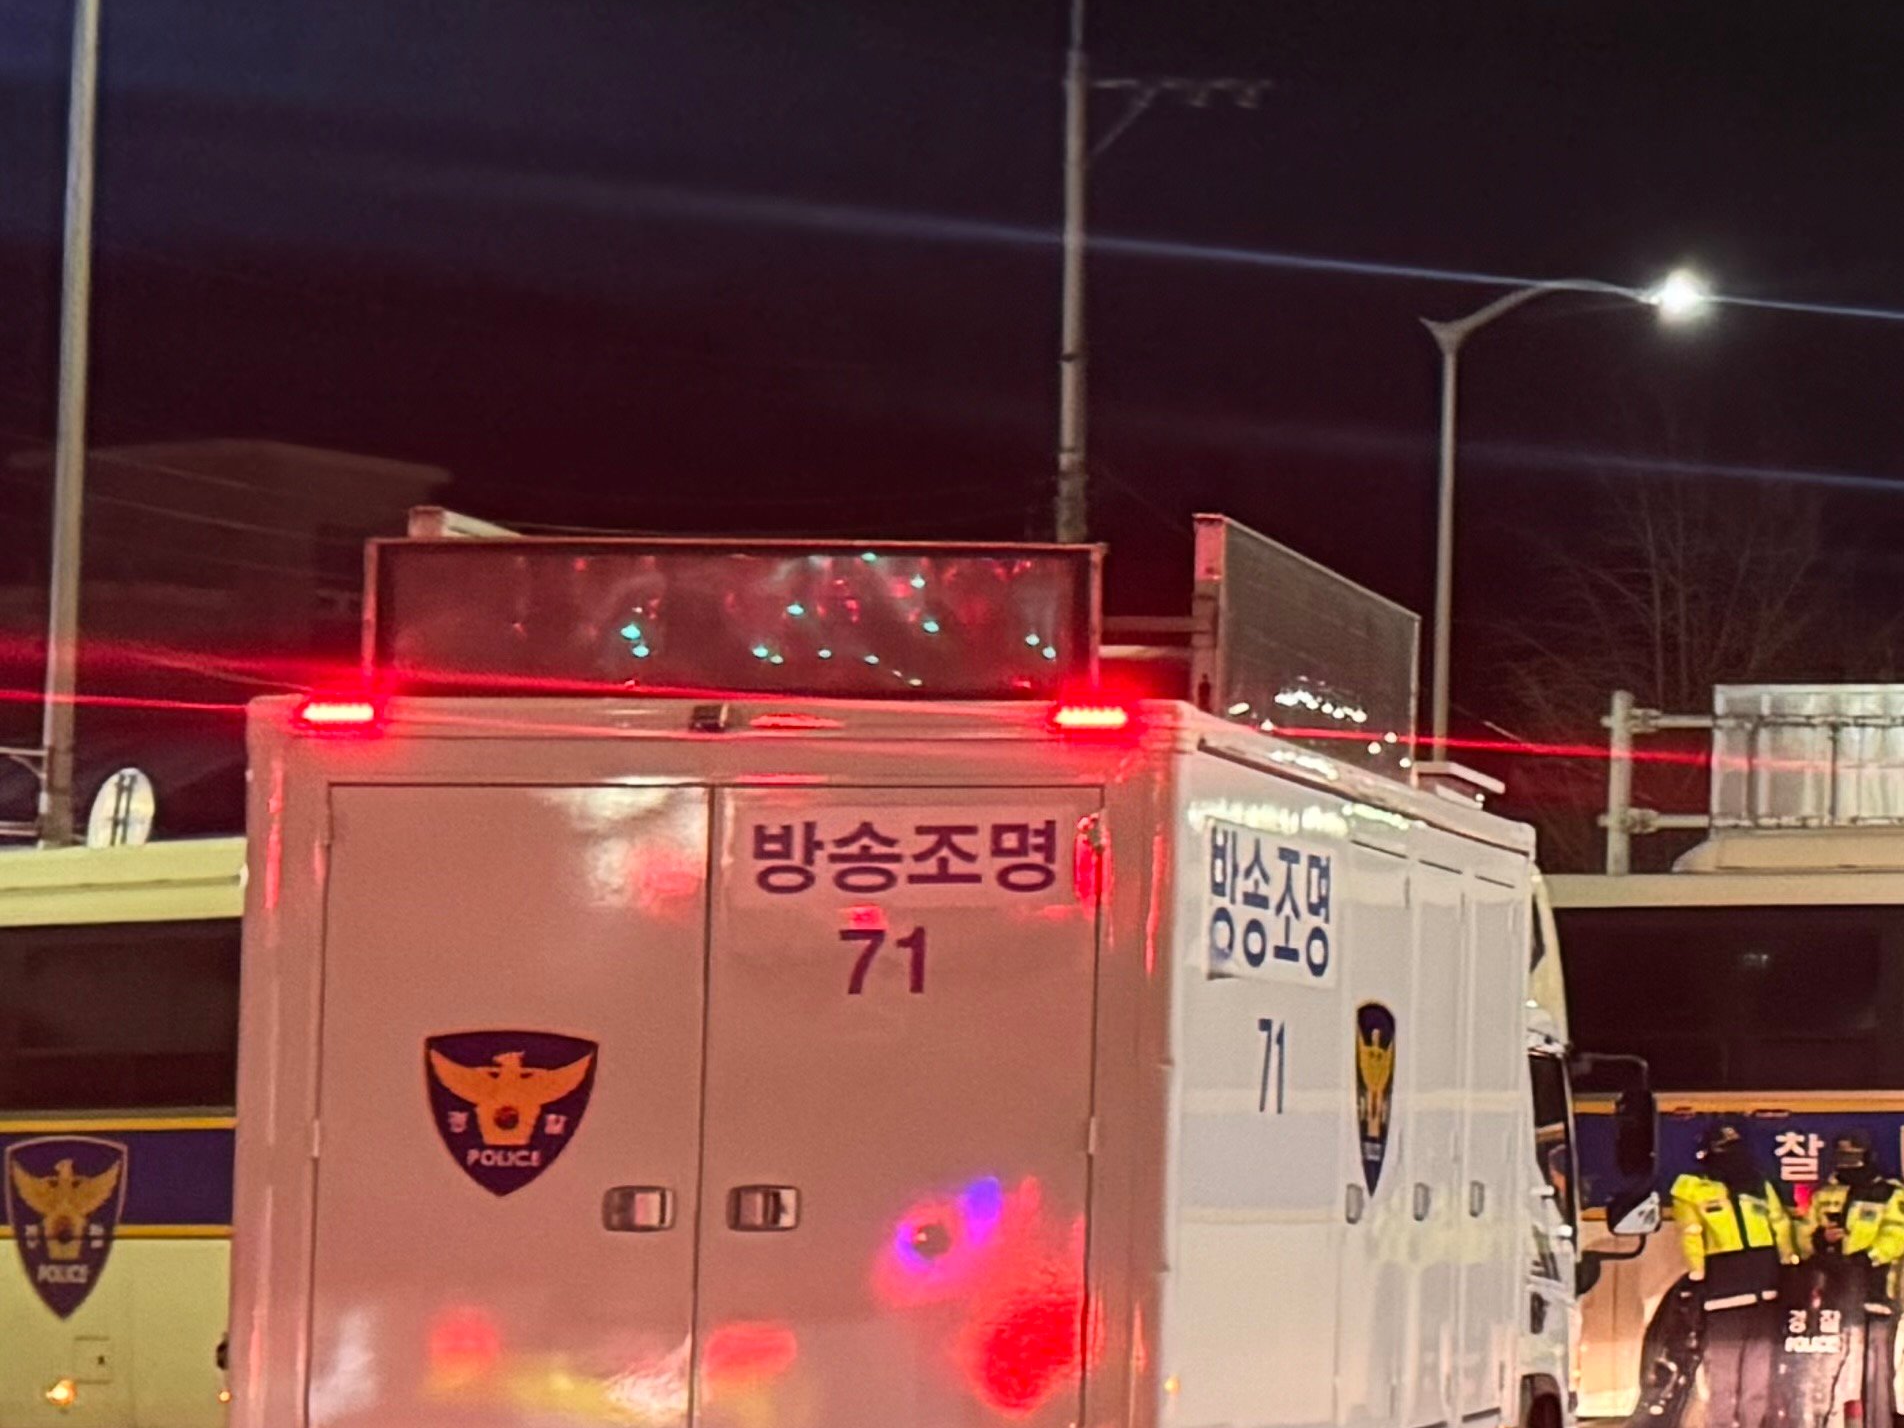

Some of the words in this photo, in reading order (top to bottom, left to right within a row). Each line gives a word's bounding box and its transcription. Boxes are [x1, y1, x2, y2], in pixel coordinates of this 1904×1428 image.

[752, 820, 1057, 894] 방송조명
[1209, 825, 1331, 978] 방송조명
[839, 926, 926, 995] 71
[1258, 1018, 1286, 1115] 71
[466, 1149, 541, 1166] POLICE
[1774, 1132, 1825, 1180] 찰
